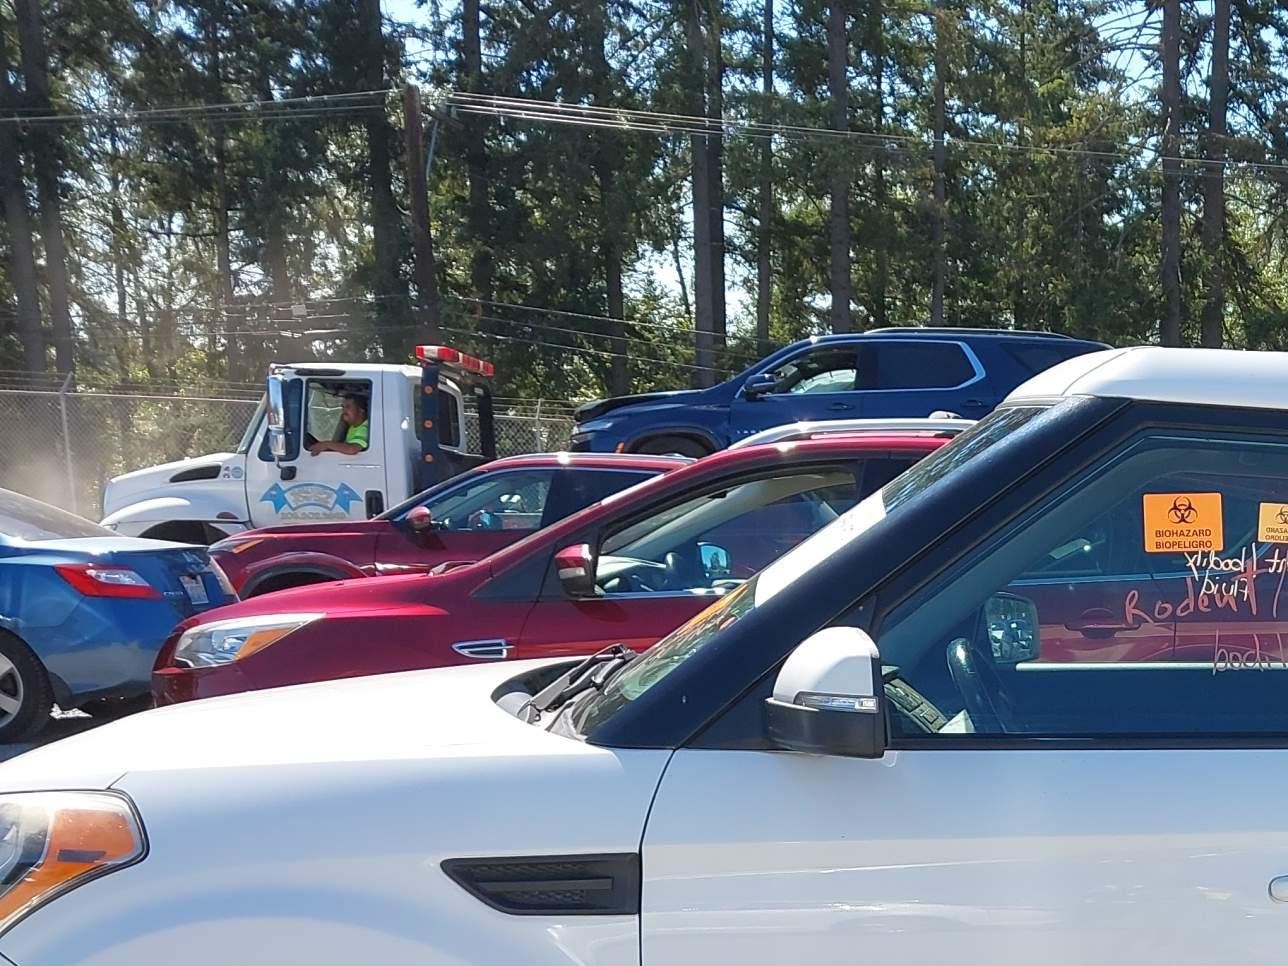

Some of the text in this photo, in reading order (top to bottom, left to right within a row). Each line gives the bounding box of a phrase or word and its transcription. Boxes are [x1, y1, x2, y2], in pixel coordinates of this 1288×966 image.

[1154, 528, 1212, 538] BIOHAZARD
[1155, 540, 1213, 550] BIOPELIGRO
[1125, 559, 1270, 625] Rodent
